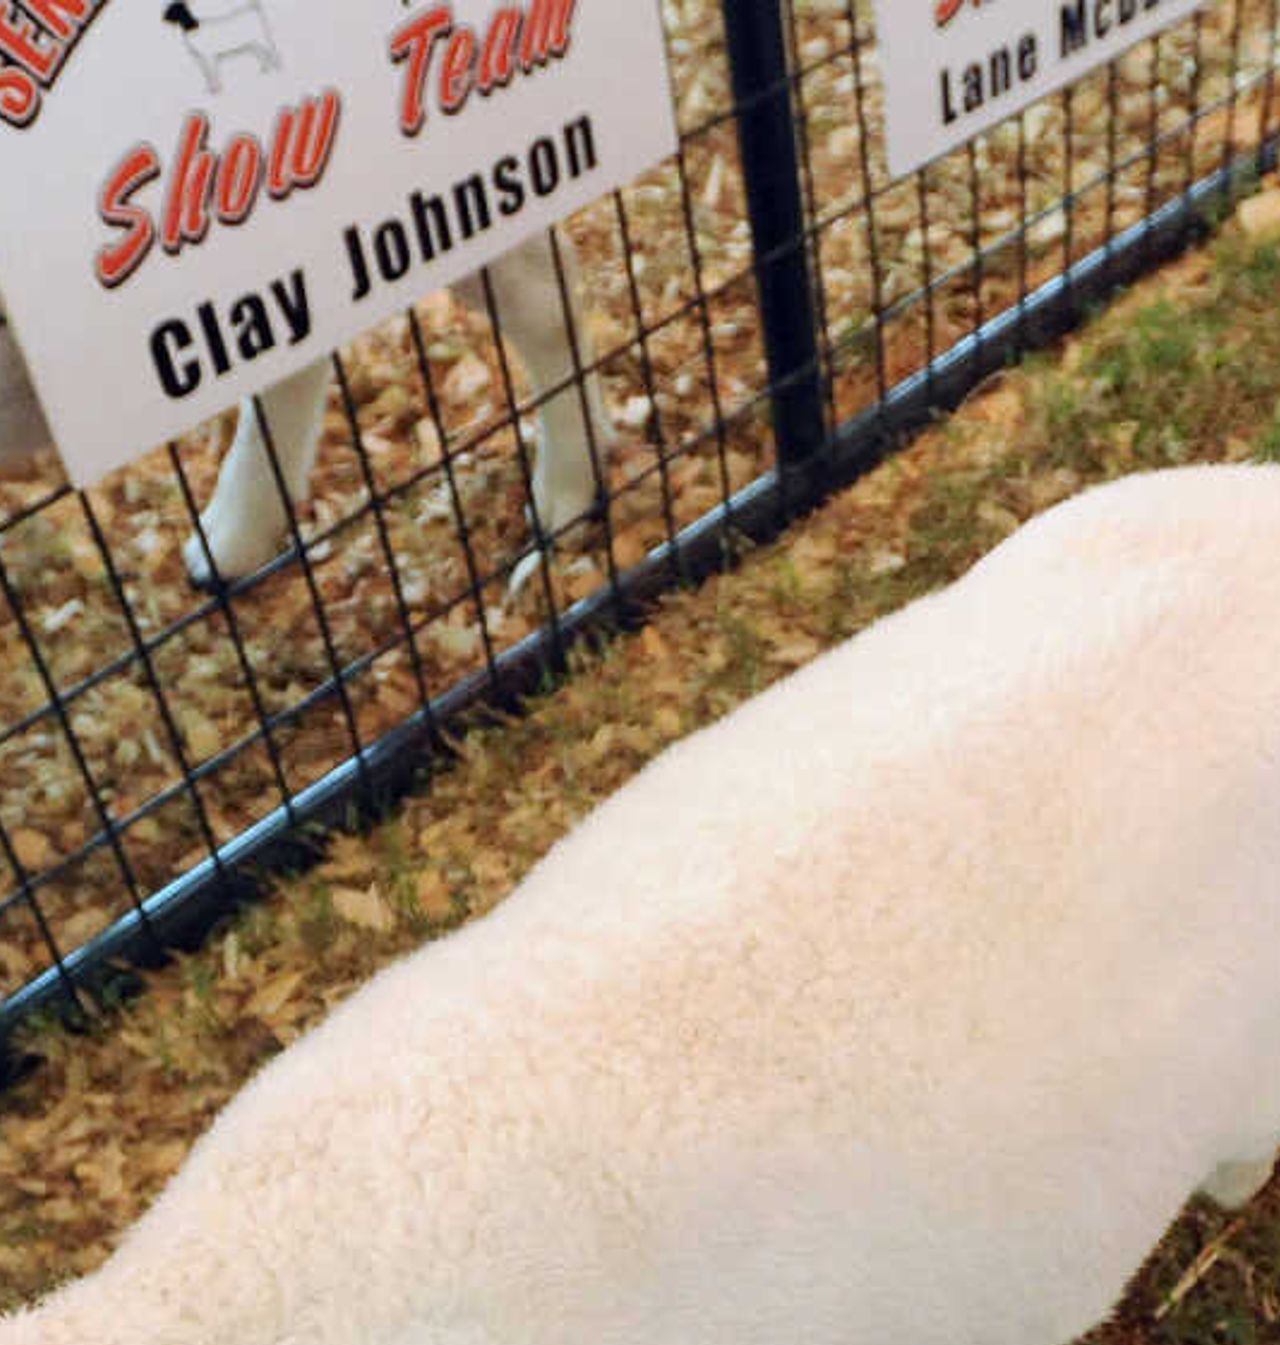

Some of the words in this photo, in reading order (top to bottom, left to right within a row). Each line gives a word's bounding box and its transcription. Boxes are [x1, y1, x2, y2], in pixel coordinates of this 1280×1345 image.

[96, 90, 342, 288] Show
[389, 0, 577, 137] Team
[940, 33, 1037, 126] Lane
[149, 267, 312, 399] Clay
[344, 115, 598, 300] Johnson
